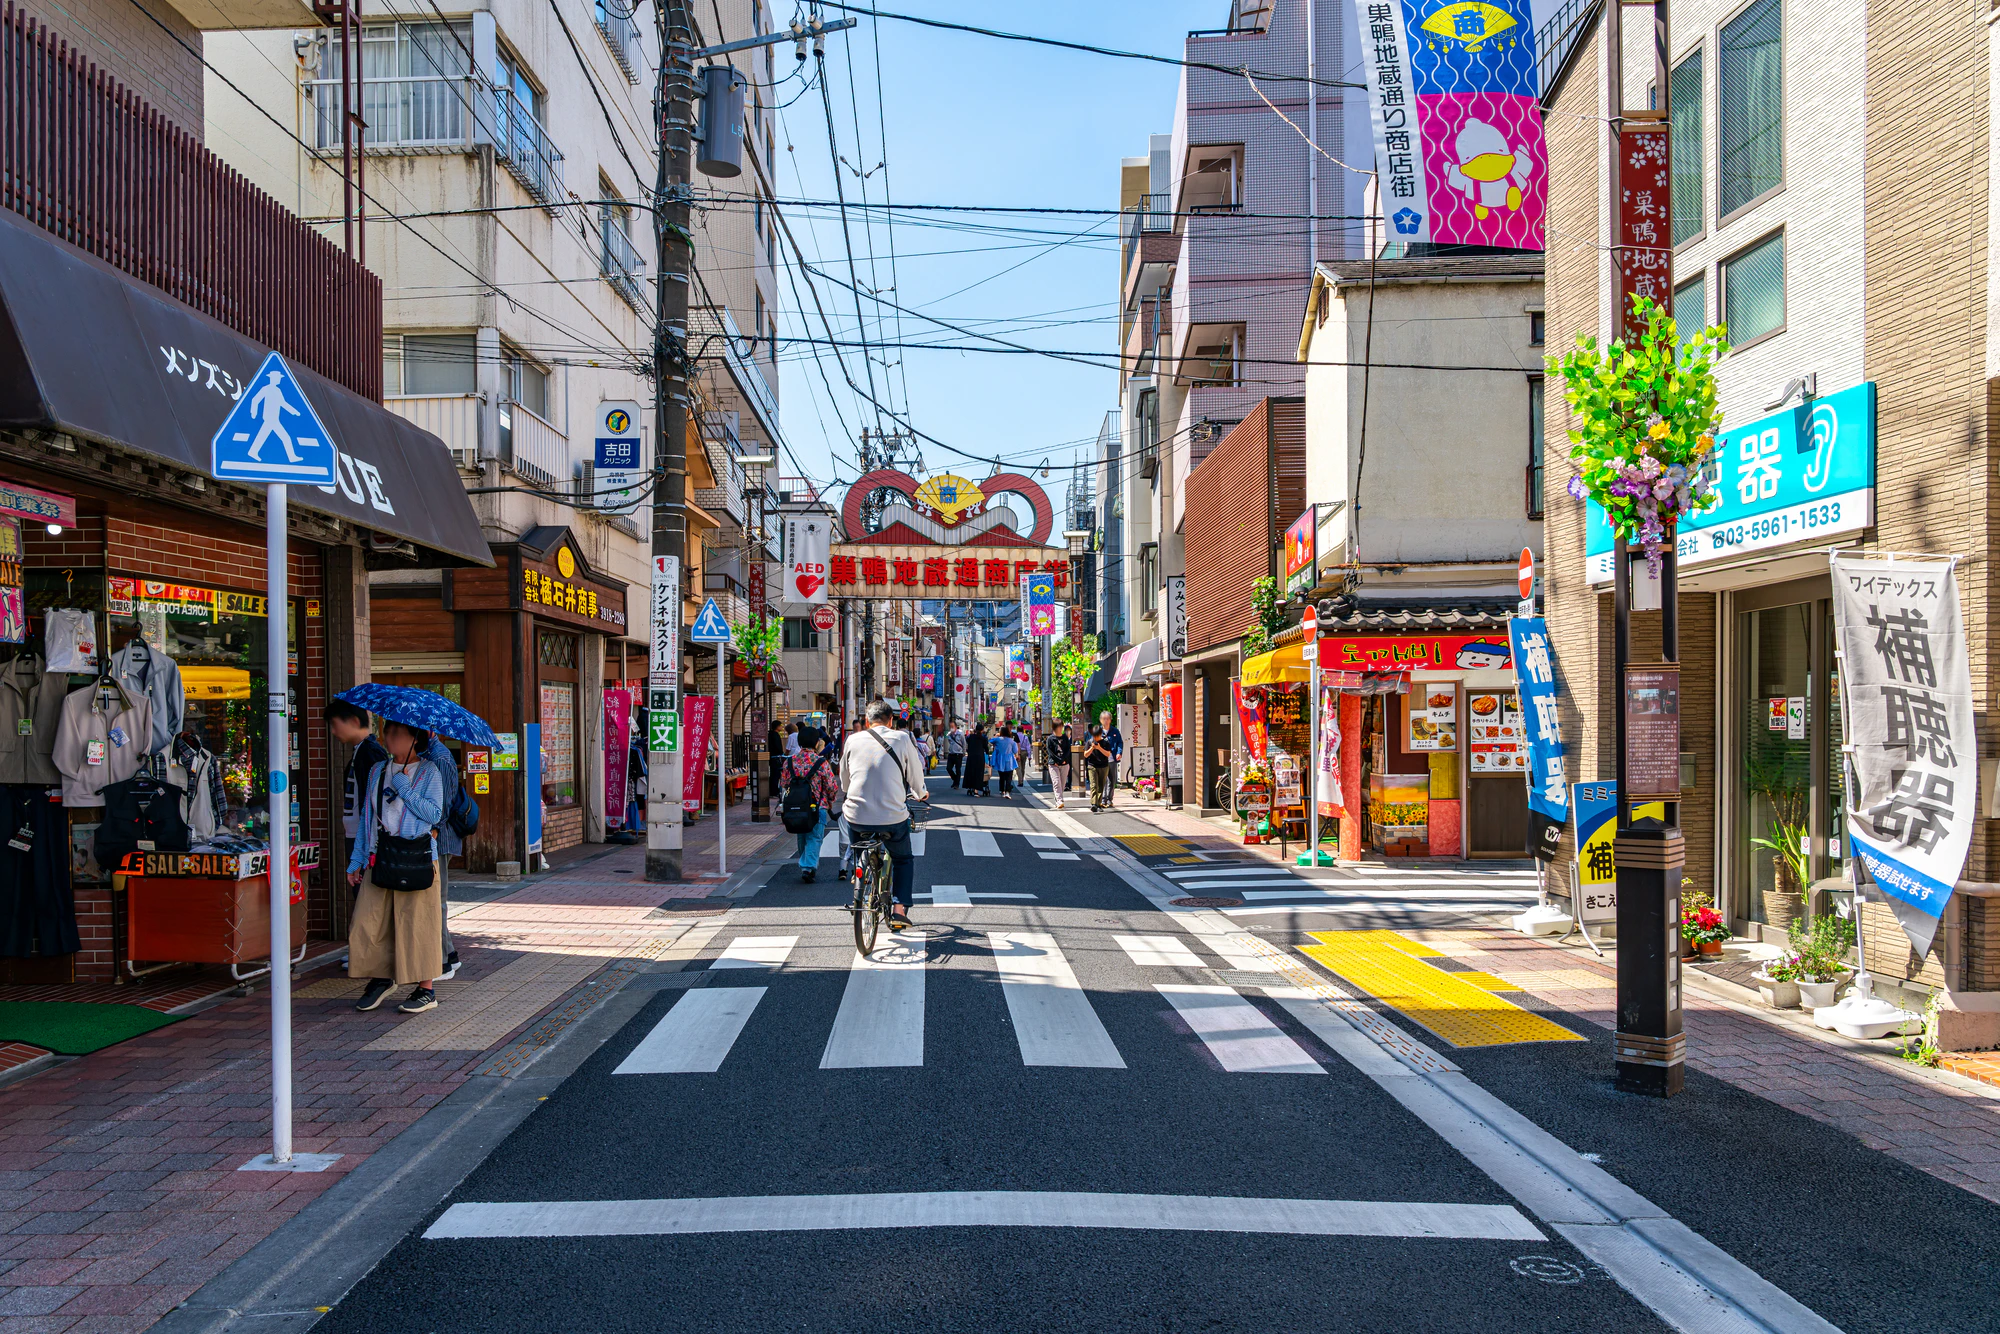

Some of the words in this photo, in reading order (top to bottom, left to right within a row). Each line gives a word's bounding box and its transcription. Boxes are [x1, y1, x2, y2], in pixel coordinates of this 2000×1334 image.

[1451, 10, 1486, 37] 商
[1368, 3, 1415, 198] 巣鴨地蔵通り商店街
[160, 346, 245, 400] メンズシ
[605, 443, 631, 456] 吉田
[322, 452, 396, 516] UE
[939, 486, 957, 504] 商
[1726, 502, 1841, 547] 03-5961-1533
[0, 564, 22, 587] ALE
[794, 563, 825, 574] AED
[1849, 575, 1938, 599] ワイデックス
[226, 594, 259, 613] SALE
[1174, 580, 1187, 635] のみくい処
[656, 583, 670, 671] ケンネルスクール
[816, 614, 834, 624] 消火栓
[1367, 663, 1429, 671] トッケビ
[652, 714, 675, 723] 通学路
[653, 723, 674, 746] 文
[1865, 604, 1958, 857] 補聴器
[146, 854, 187, 875] SALE
[192, 854, 230, 875] SALE
[298, 846, 320, 865] ALE
[1586, 841, 1617, 880] 補
